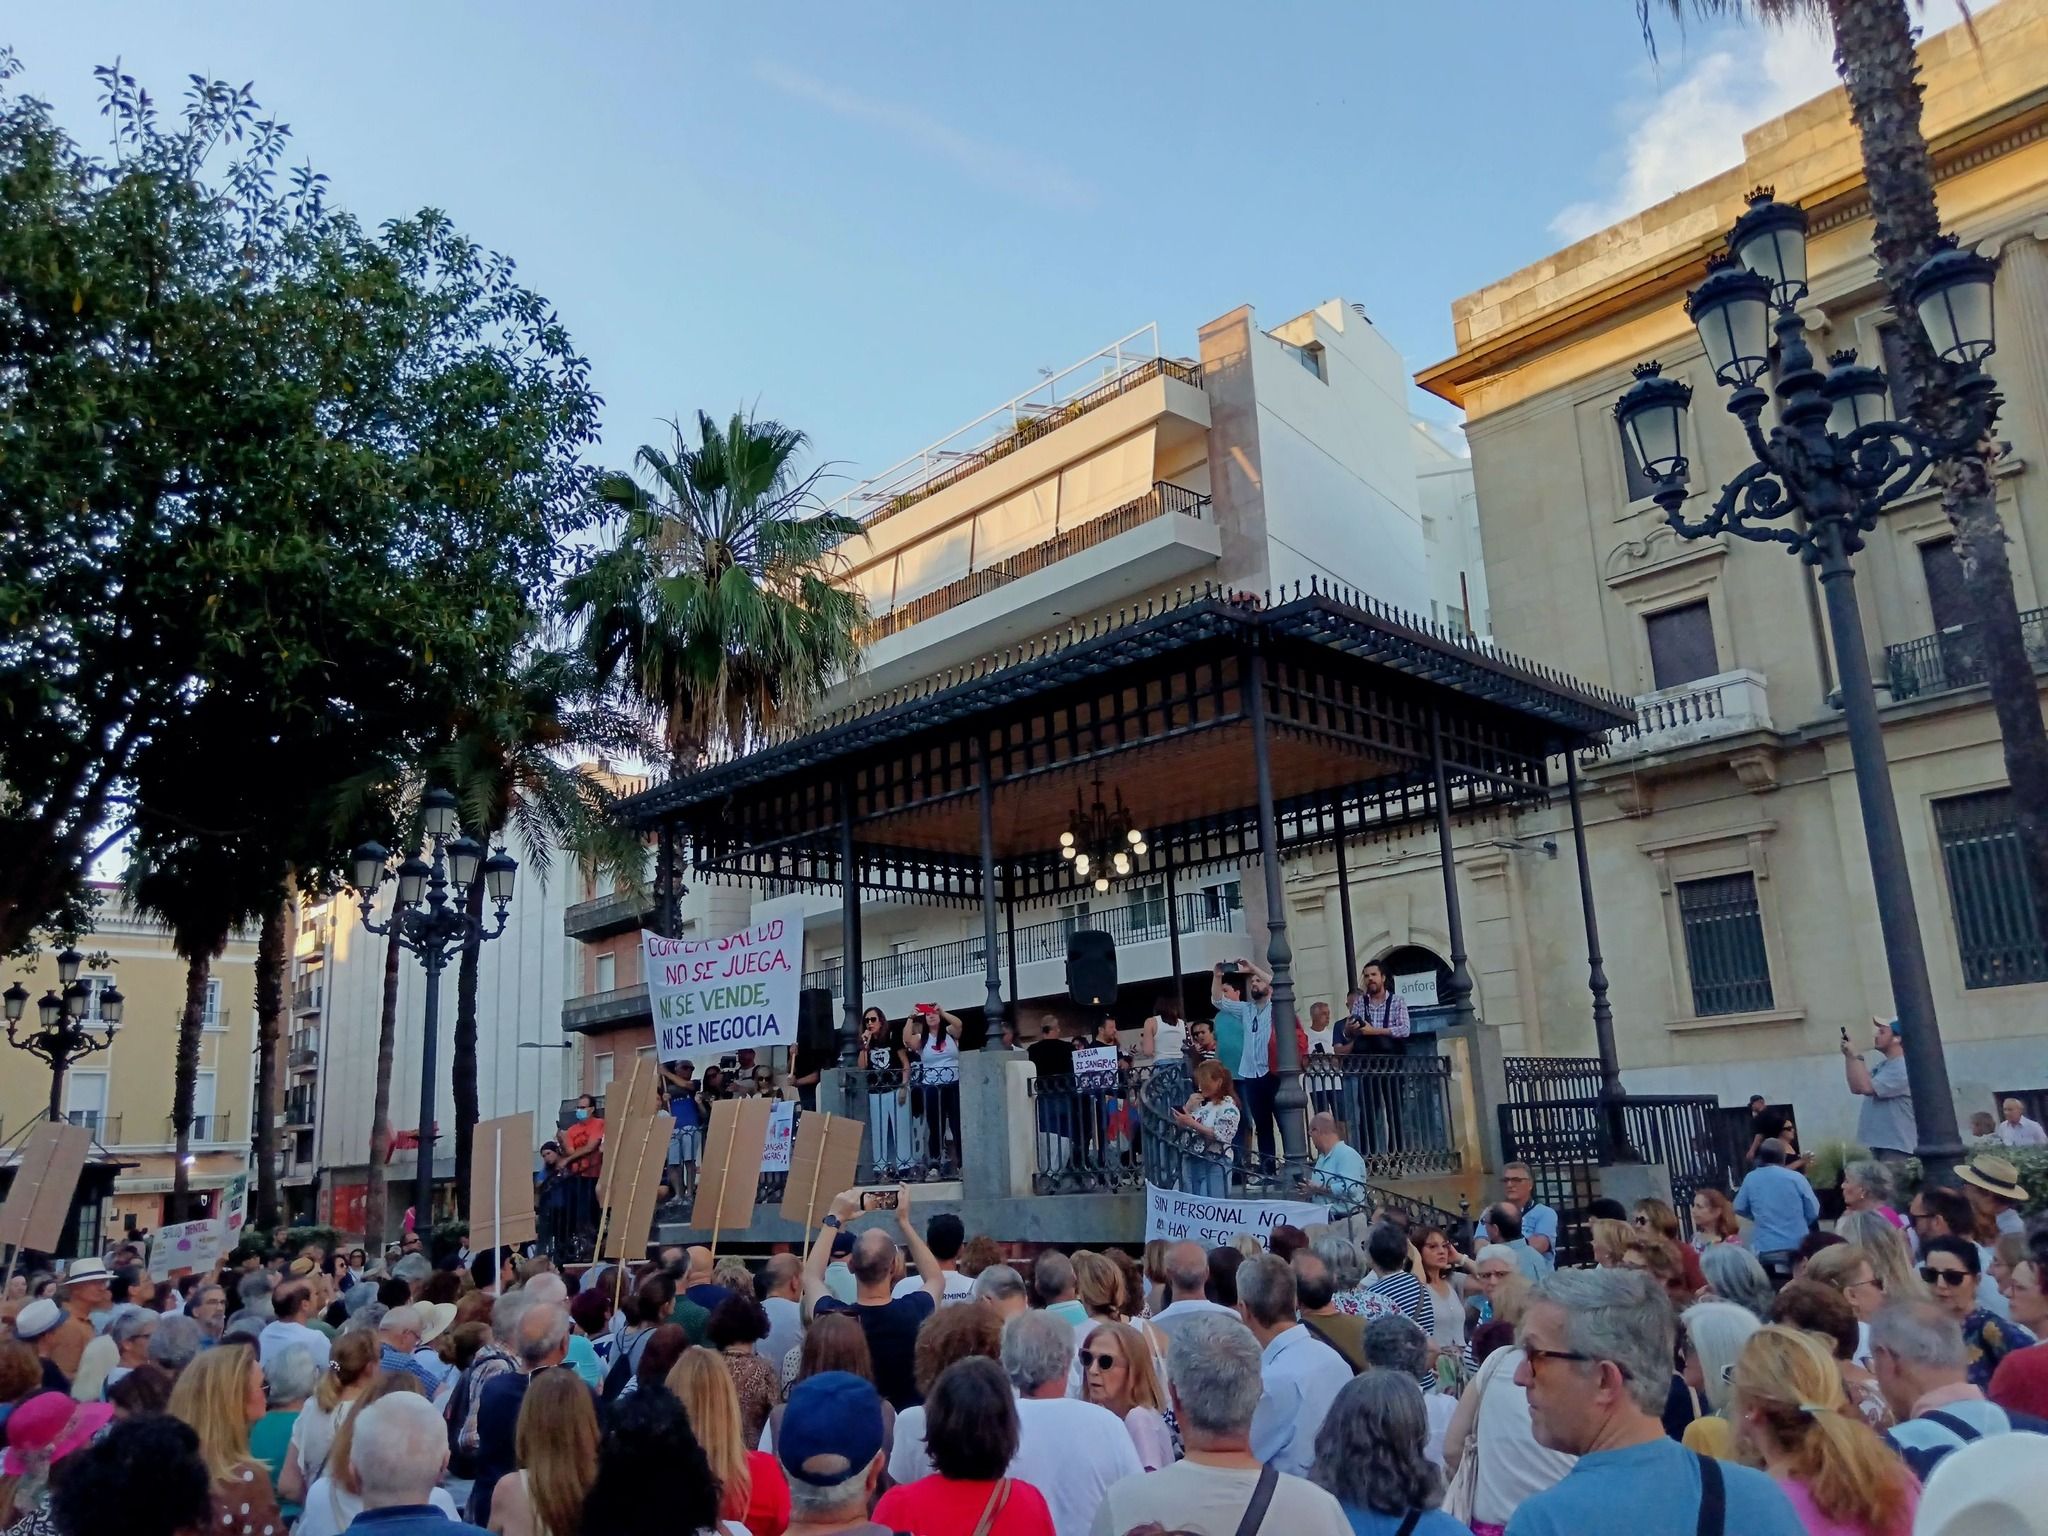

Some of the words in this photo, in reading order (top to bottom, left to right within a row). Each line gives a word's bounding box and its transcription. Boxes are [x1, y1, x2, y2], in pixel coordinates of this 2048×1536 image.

[666, 963, 687, 985] NO
[692, 961, 718, 982] SE
[722, 949, 791, 977] JUEGA,
[659, 996, 672, 1019] NI
[676, 993, 695, 1017] SE
[700, 982, 770, 1011] VENDE,
[662, 1028, 673, 1050] NI
[675, 1023, 693, 1049] SE
[698, 1013, 780, 1044] NEGOCIA
[1154, 1195, 1168, 1213] SIN
[1173, 1200, 1247, 1225] PERSONAL
[1258, 1210, 1287, 1228] NO
[1168, 1221, 1191, 1239] HAY
